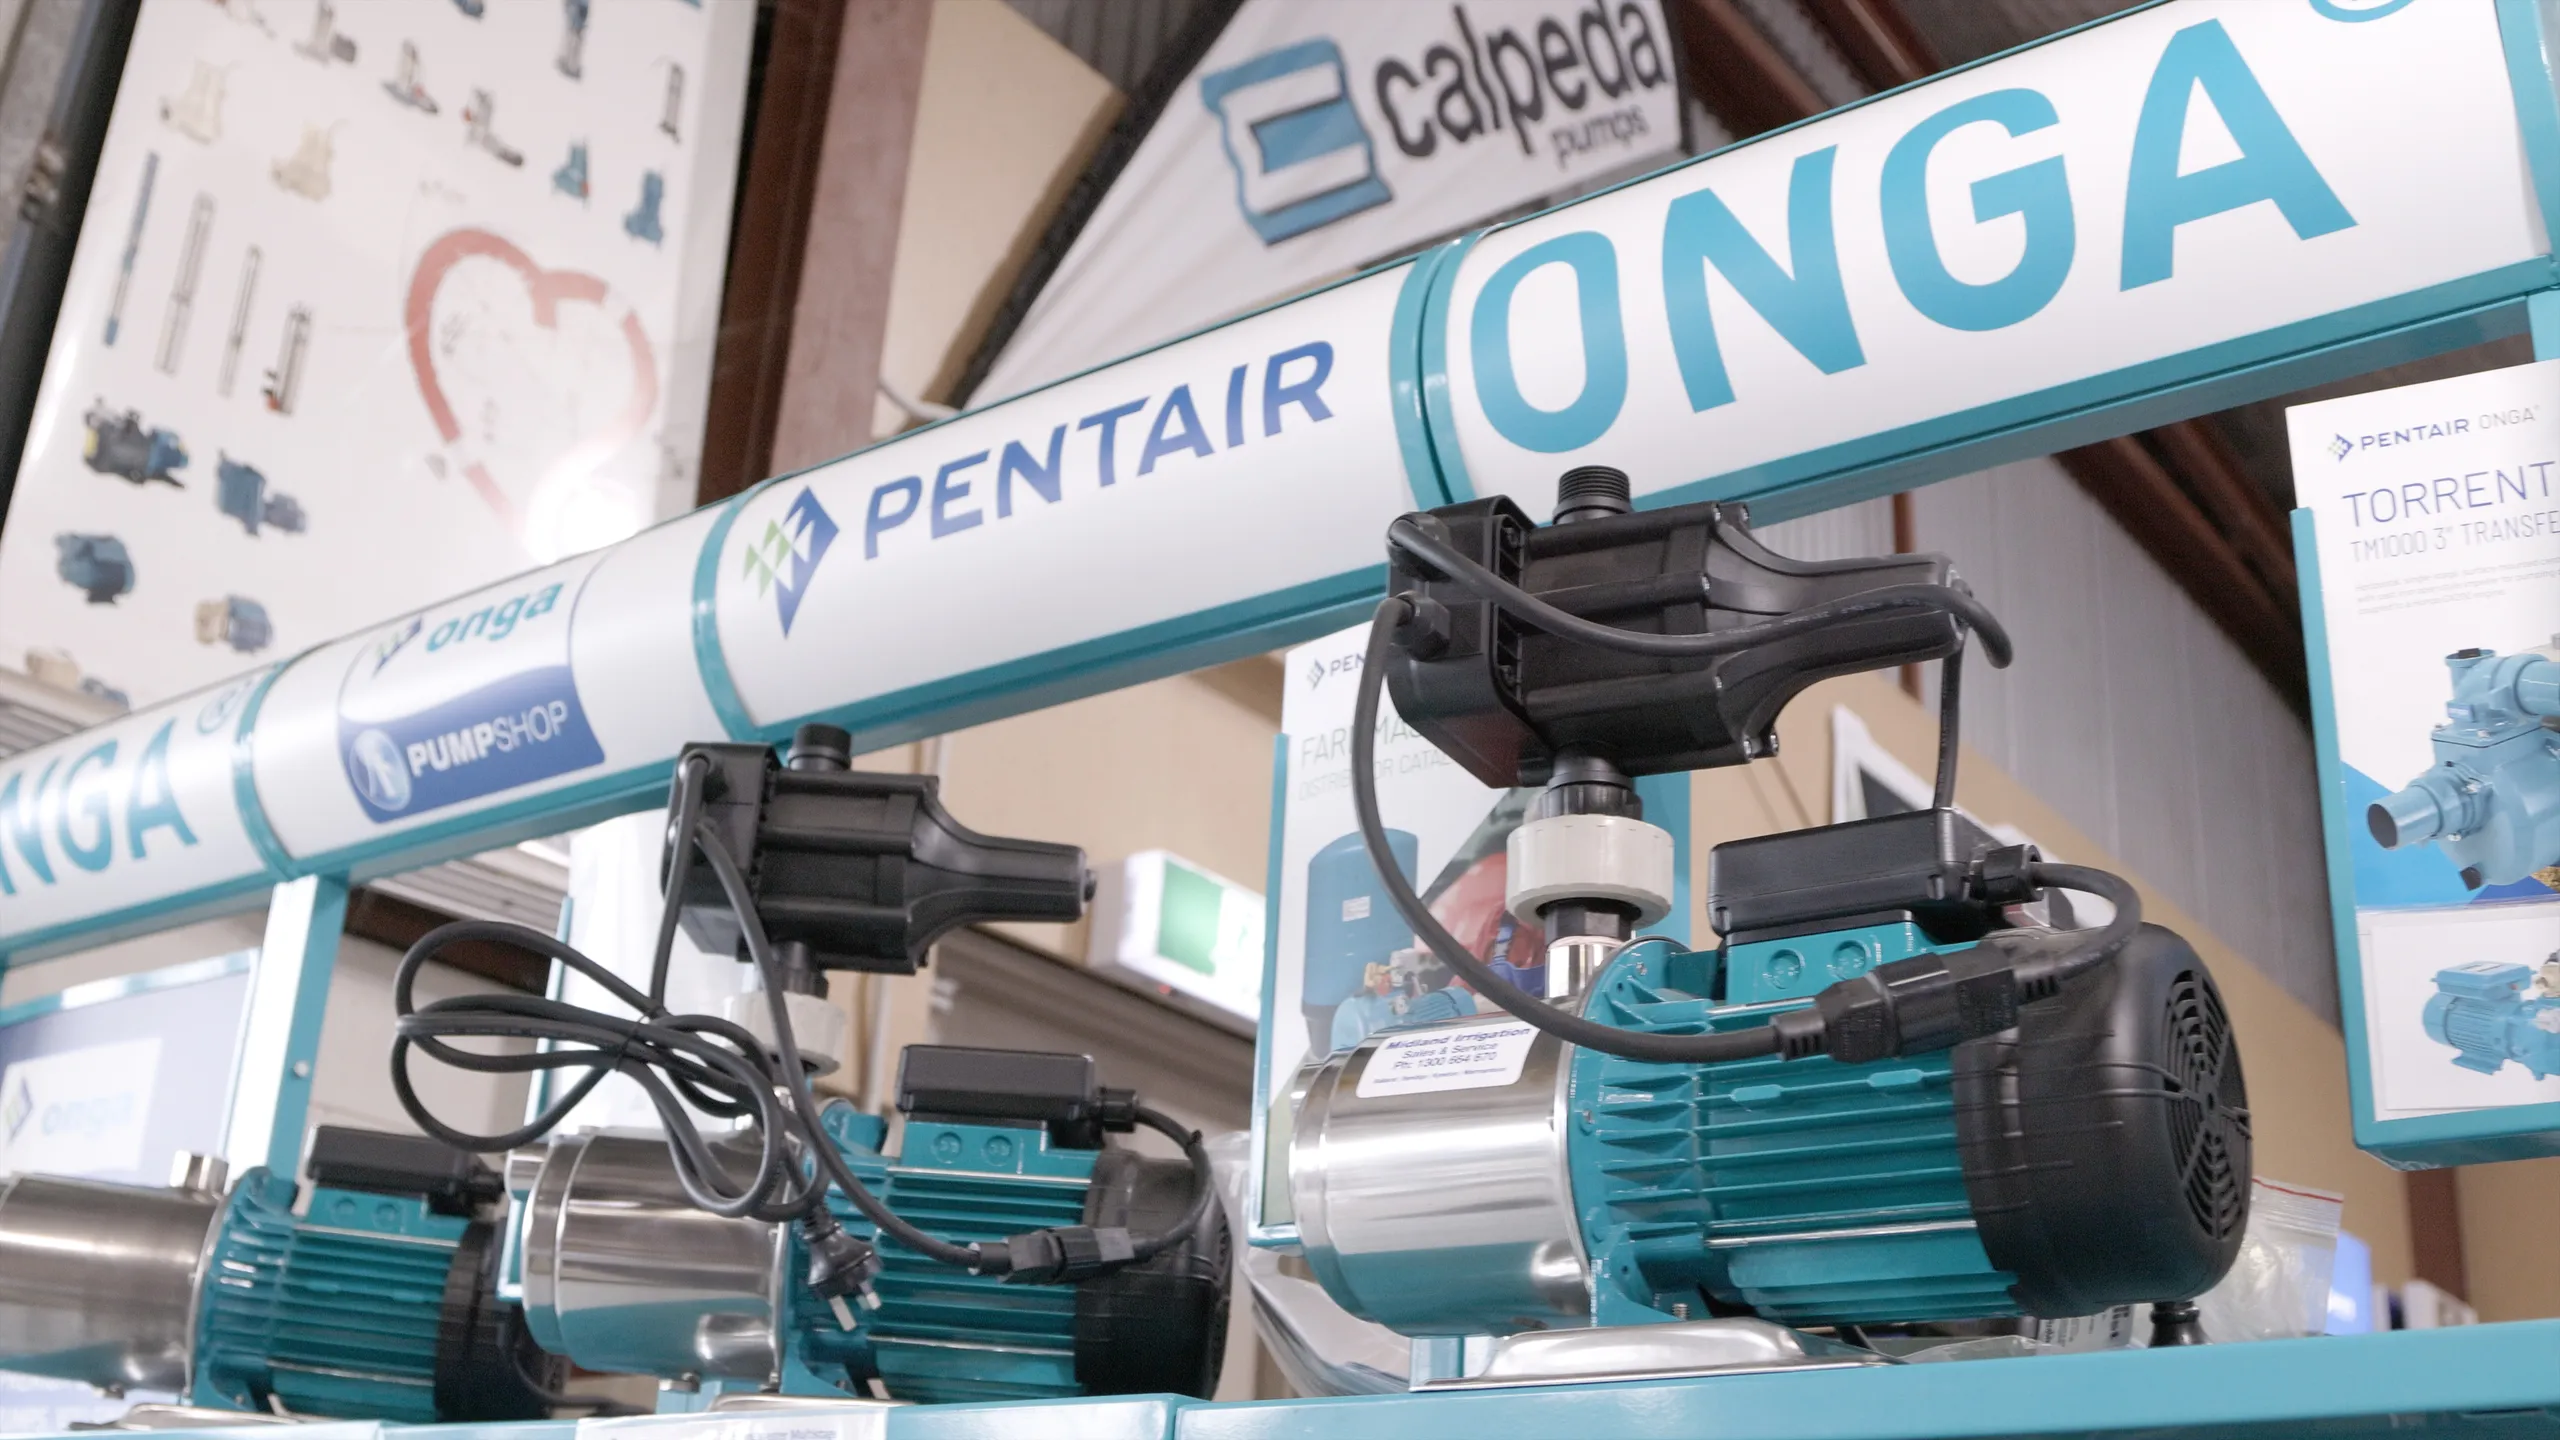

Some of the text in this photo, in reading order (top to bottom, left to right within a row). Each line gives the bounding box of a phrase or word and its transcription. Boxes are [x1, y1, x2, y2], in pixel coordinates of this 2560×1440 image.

[1374, 0, 1668, 158] calpeda
[1551, 106, 1648, 168] pumps
[1470, 17, 2359, 453] ONGA
[864, 340, 1335, 560] PENTAIR
[2360, 418, 2470, 451] PENTAIR
[2342, 460, 2556, 528] TORRENT
[2350, 530, 2428, 563] TM1000
[2460, 510, 2560, 547] TRANSFE
[425, 581, 566, 653] onga
[408, 700, 569, 778] PUMPSHOP
[0, 717, 198, 896] NGA
[1386, 1028, 1532, 1050] Midland Irrigation
[1451, 1043, 1499, 1054] Service
